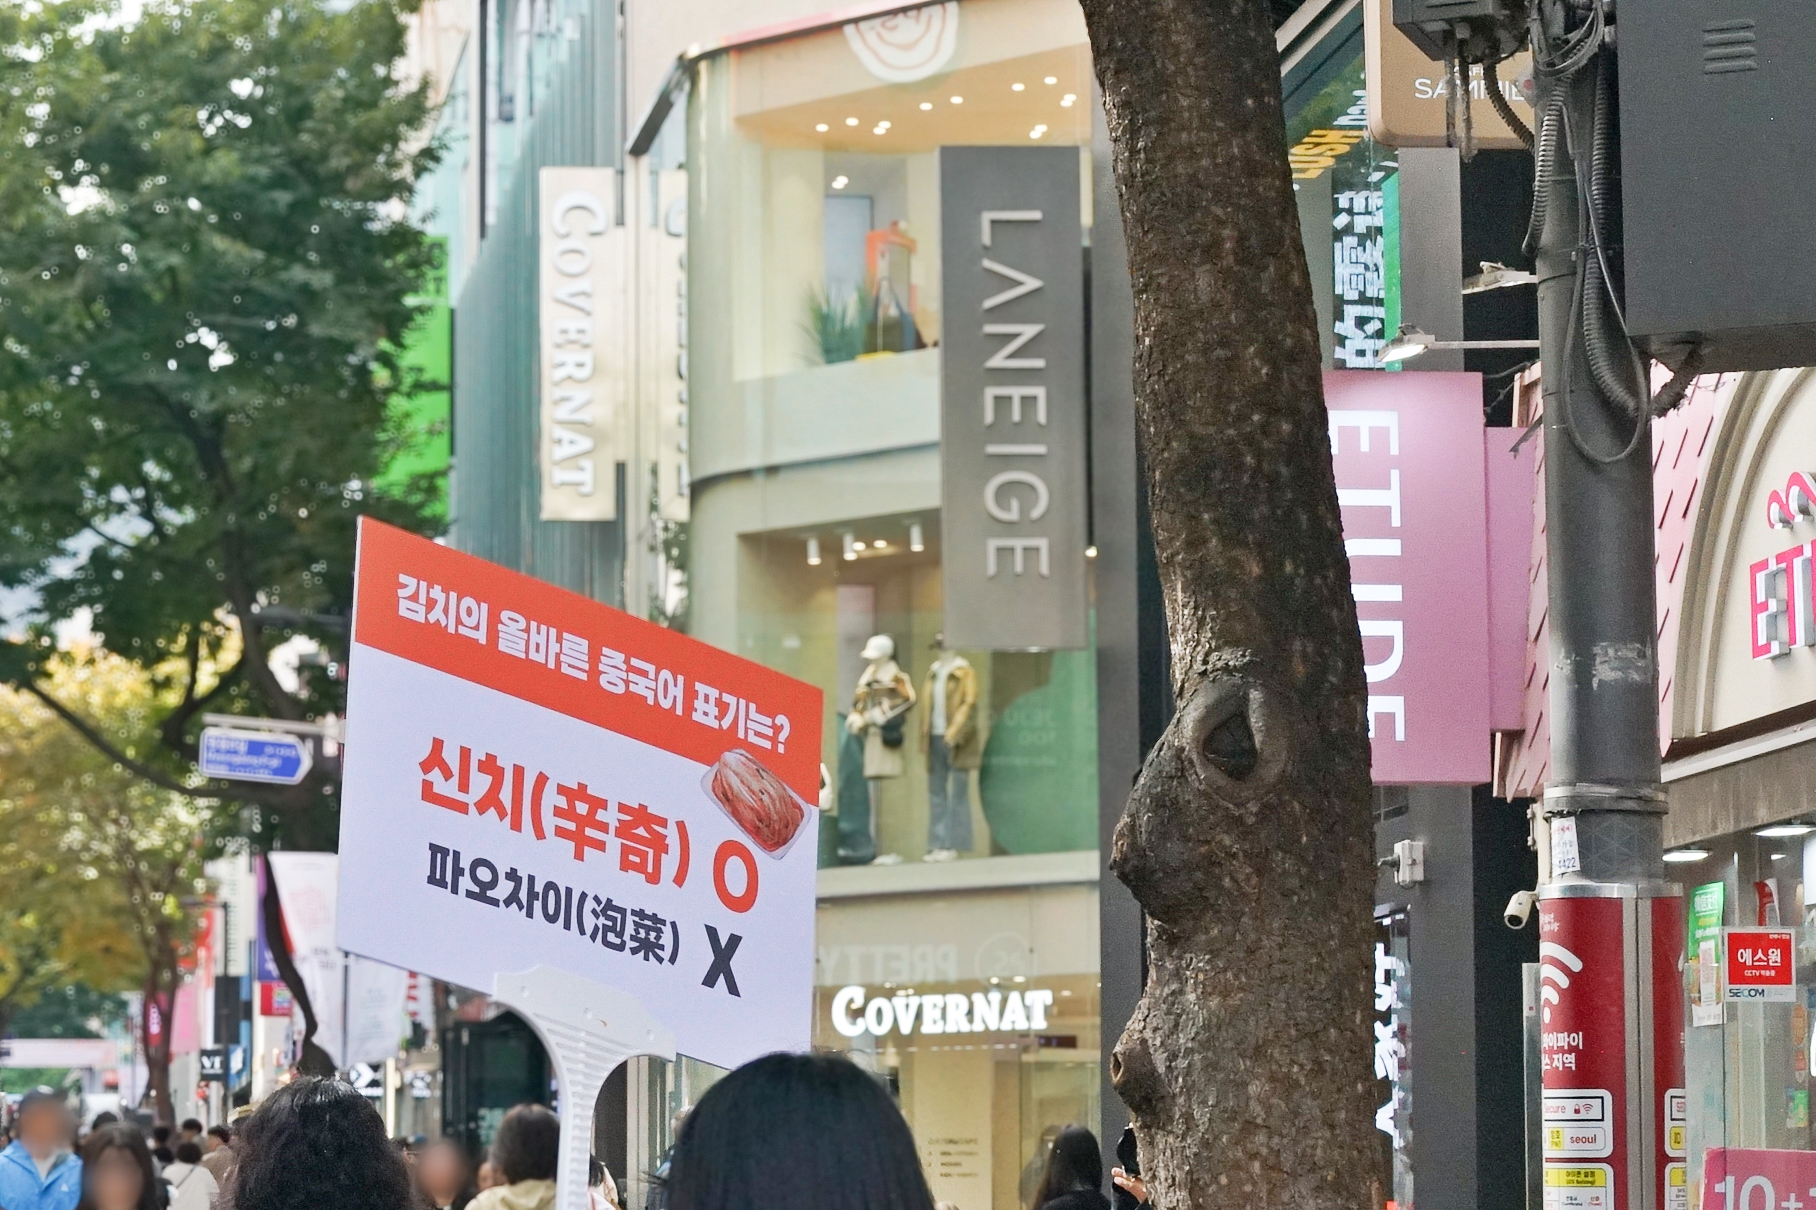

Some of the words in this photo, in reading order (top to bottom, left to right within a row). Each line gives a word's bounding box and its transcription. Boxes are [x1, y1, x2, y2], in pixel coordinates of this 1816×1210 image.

[1288, 129, 1366, 180] LUSH
[550, 190, 607, 498] COVERNAT
[981, 209, 1050, 578] LANEIGE
[1749, 538, 1816, 659] ET
[396, 572, 488, 645] 김치의
[497, 609, 589, 682] 올바른
[597, 646, 684, 717] 중국어
[692, 680, 791, 755] 표기는?
[417, 736, 691, 889] 신치(辛奇)
[426, 842, 680, 966] 파오차이(泡菜)
[701, 924, 743, 998] X
[1737, 948, 1782, 967] 에스원
[831, 985, 1054, 1037] COVERNAT
[1729, 988, 1765, 998] SECOM
[1570, 1134, 1597, 1144] seoul
